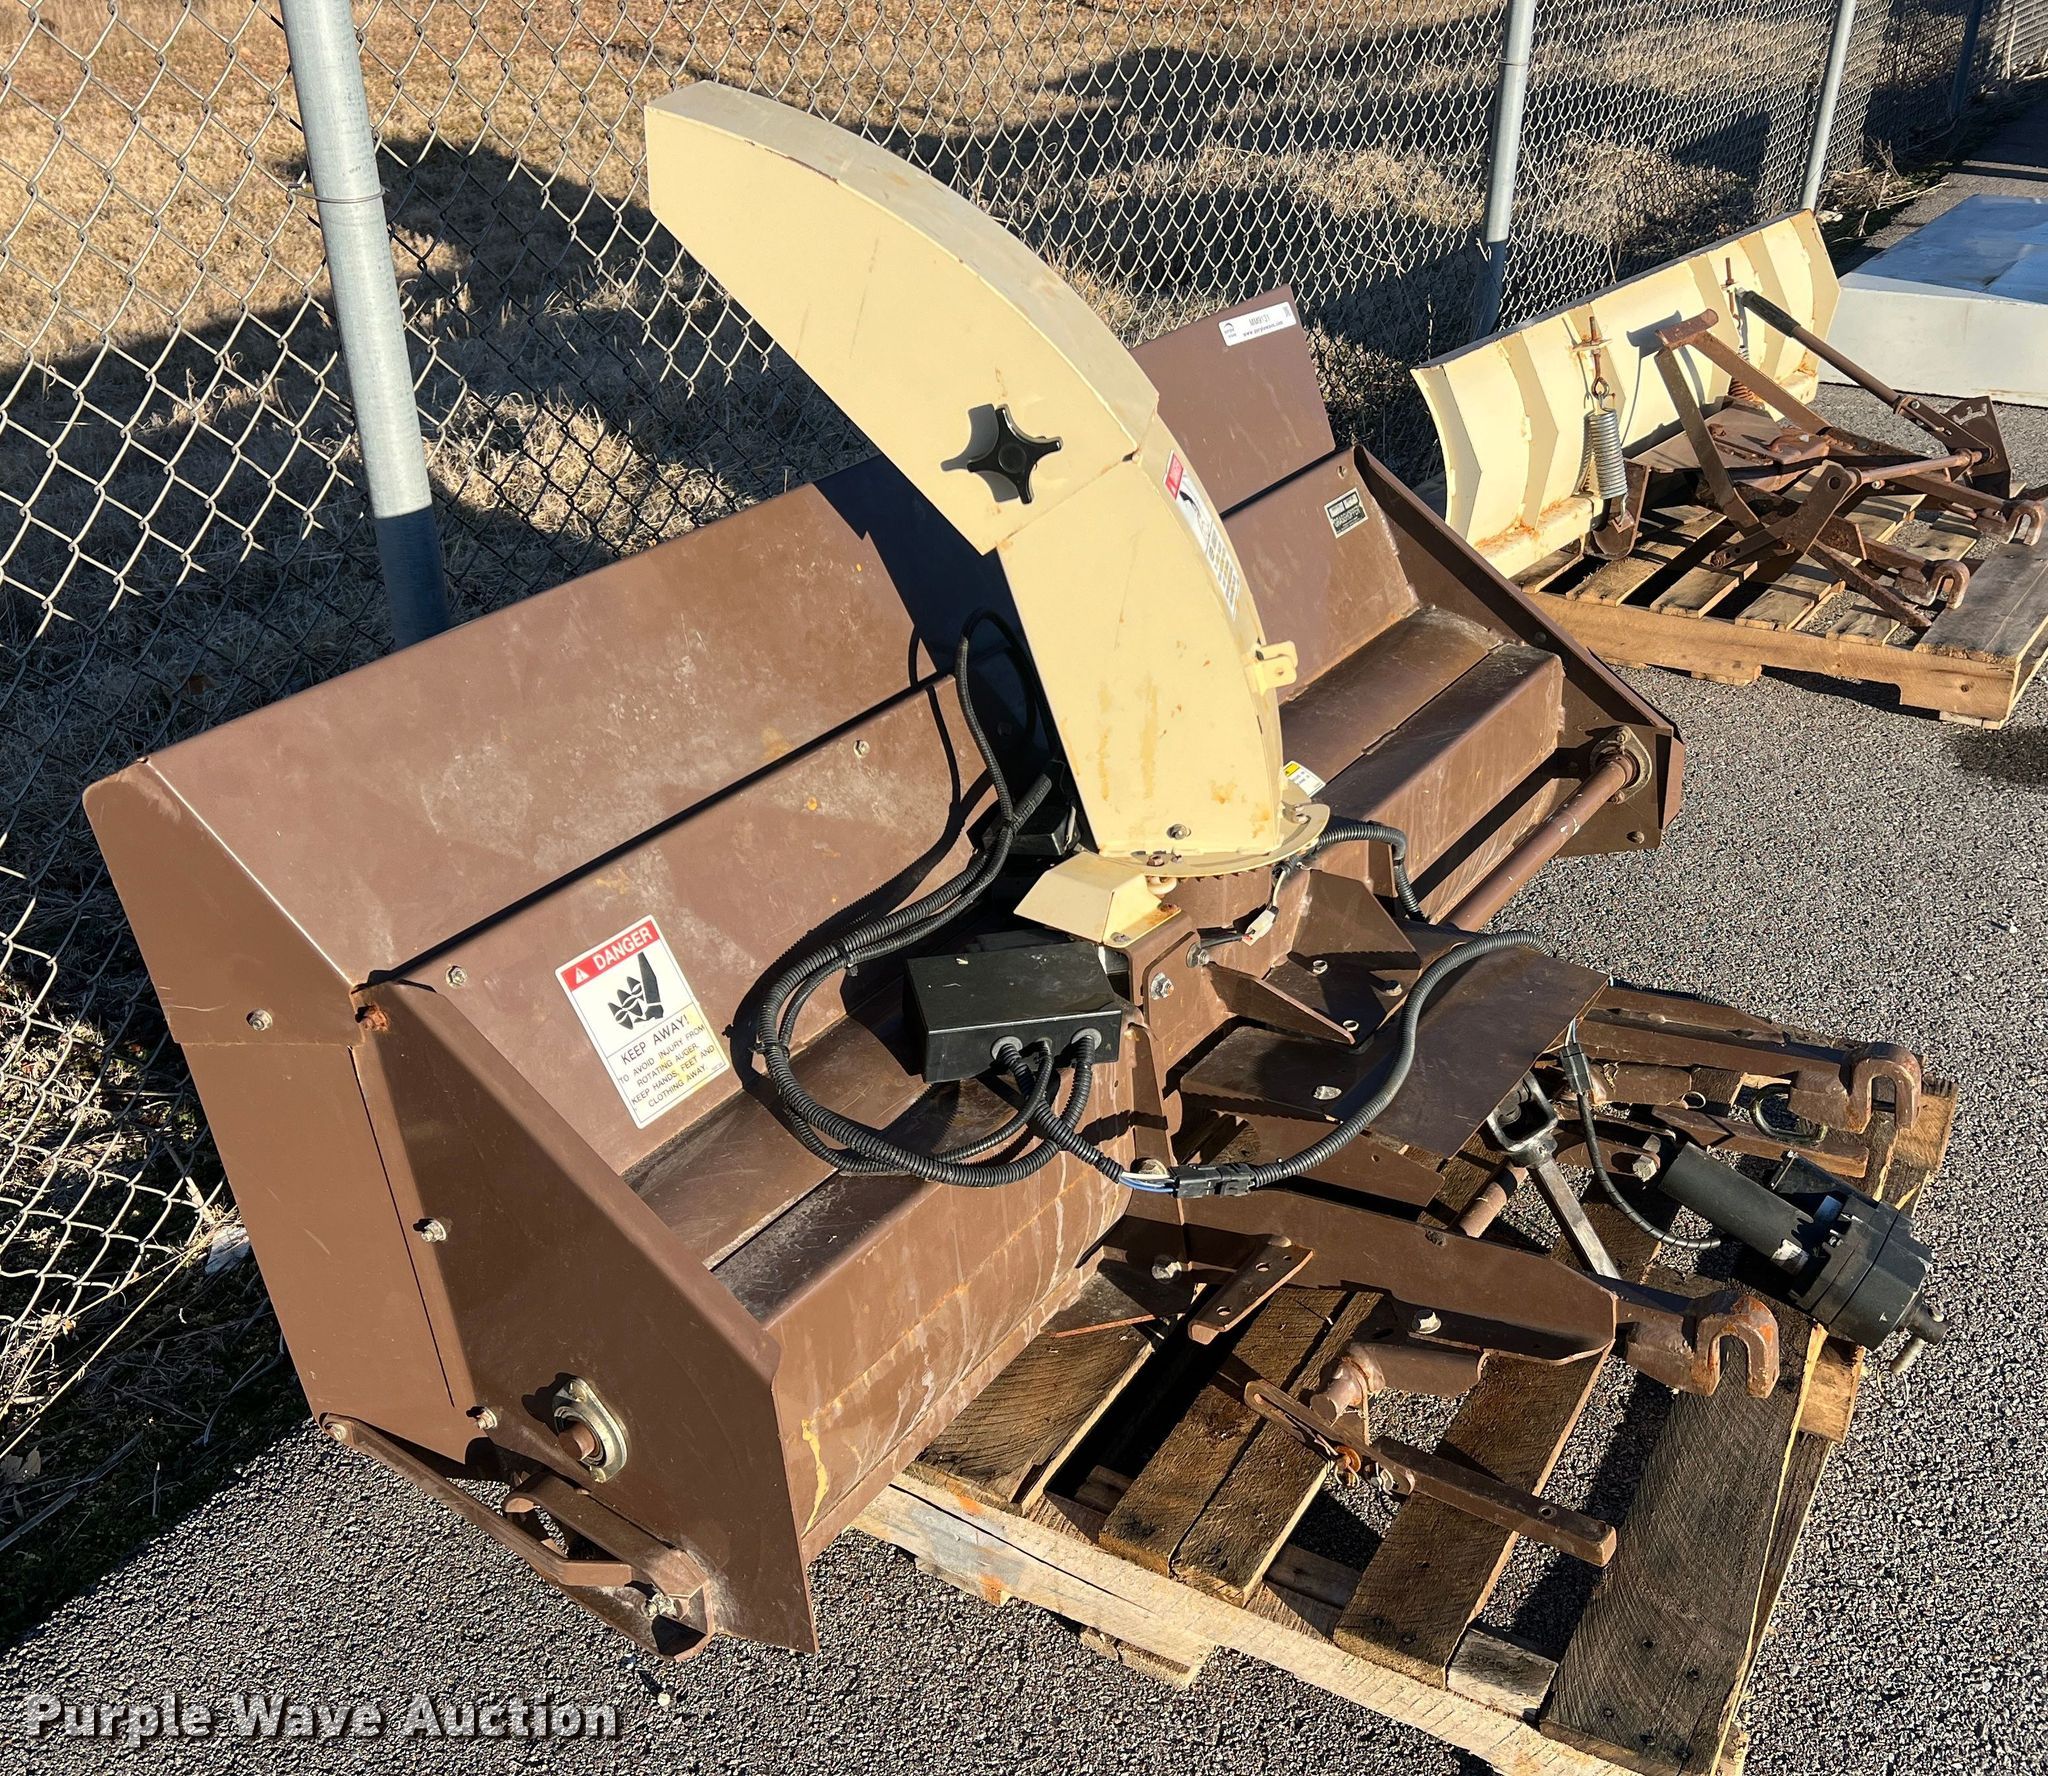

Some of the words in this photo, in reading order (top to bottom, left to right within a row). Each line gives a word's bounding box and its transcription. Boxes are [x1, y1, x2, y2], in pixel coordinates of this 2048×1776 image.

[592, 926, 653, 970] DANGER
[619, 1073, 630, 1085] TO
[633, 1057, 655, 1076] AVOID
[658, 1040, 684, 1059] INJURY
[686, 1024, 706, 1043] FROM
[620, 1041, 647, 1066] KEEP
[653, 1014, 690, 1046] AWAY!
[631, 1087, 650, 1105] KEEP
[680, 1057, 698, 1073] FEET
[700, 1044, 716, 1060] AND
[636, 1061, 674, 1088] ROTATING
[648, 1079, 686, 1108] CLOTHING
